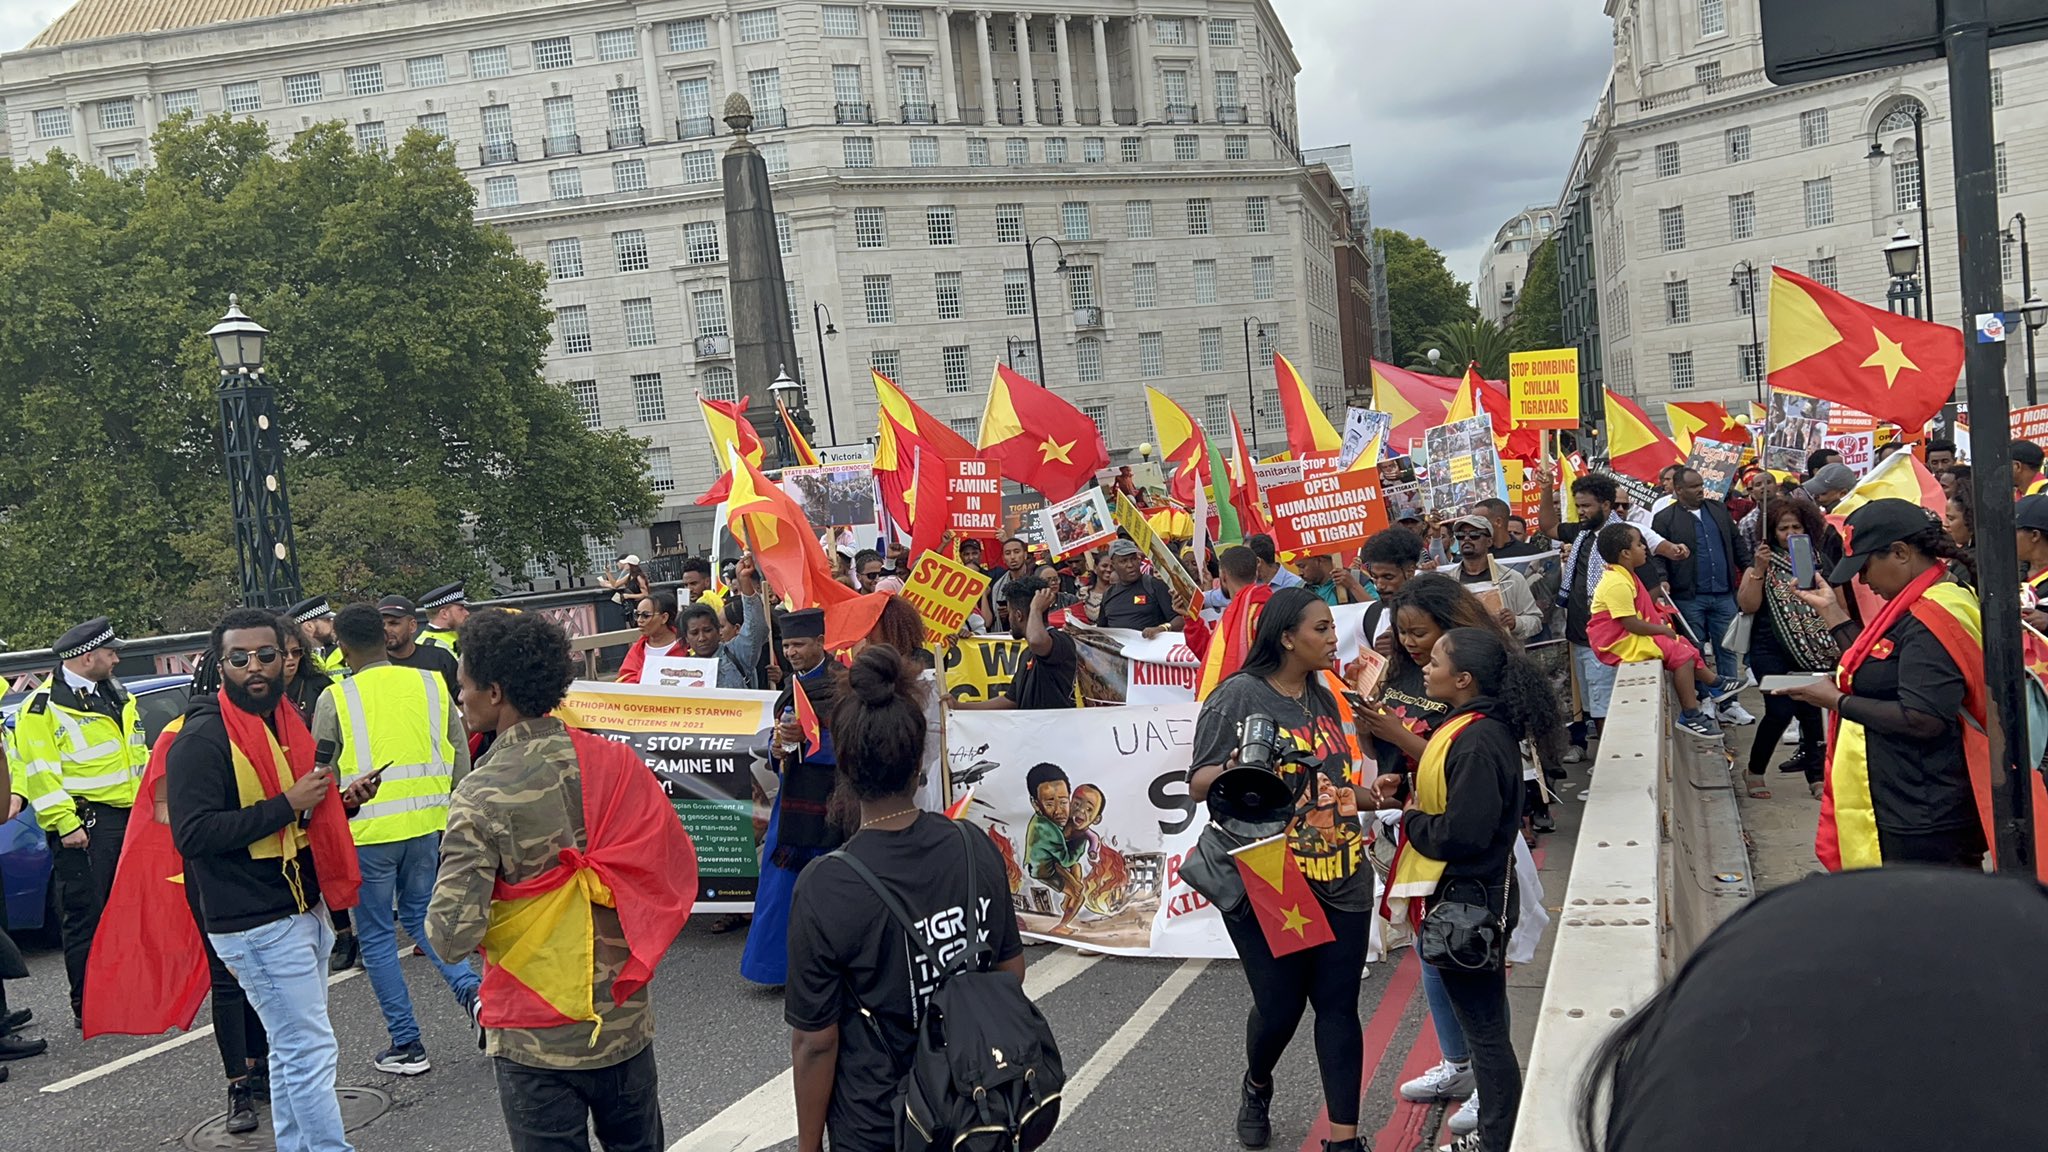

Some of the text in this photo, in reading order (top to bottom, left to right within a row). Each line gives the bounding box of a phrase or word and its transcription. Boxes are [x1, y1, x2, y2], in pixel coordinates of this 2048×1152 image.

[1511, 359, 1575, 377] STOP BOMBING
[1524, 380, 1559, 395] CIVILIAN
[1521, 399, 1568, 414] TIGRAYANS
[2011, 427, 2022, 440] SS
[831, 452, 862, 461] Victoria
[1303, 457, 1326, 470] STOP
[1844, 452, 1868, 465] CIDE
[803, 466, 840, 475] SANCTIONED
[842, 463, 871, 471] GENOCIDE
[960, 461, 986, 476] END
[949, 479, 998, 493] FAMINE
[1304, 476, 1340, 495] OPEN
[1507, 482, 1521, 491] pia
[1522, 481, 1536, 491] OP
[967, 496, 980, 510] IN
[1009, 502, 1040, 512] TIGRAY!
[1275, 486, 1377, 518] HUMANITARIAN
[952, 513, 996, 528] TIGRAY
[1291, 505, 1367, 531] CORRIDORS
[1526, 518, 1539, 527] TIG
[1300, 521, 1364, 545] IN TIGRAY
[913, 557, 984, 602] STOP
[902, 589, 964, 630] KILLING
[569, 699, 621, 712] ETHIOPIAN
[623, 704, 680, 715] GOVERMENT
[683, 706, 693, 715] IS
[695, 707, 743, 718] STARVING
[582, 715, 705, 729] ITS OWN CITIZENS IN 2021
[647, 736, 694, 751] STOP
[699, 737, 735, 751] THE
[1113, 719, 1193, 755] UAE
[645, 758, 734, 774] FAMINE IN
[693, 803, 736, 811] Government
[705, 835, 739, 843] Tigrayans
[1167, 890, 1213, 919] KID
[914, 897, 991, 946] IGRY
